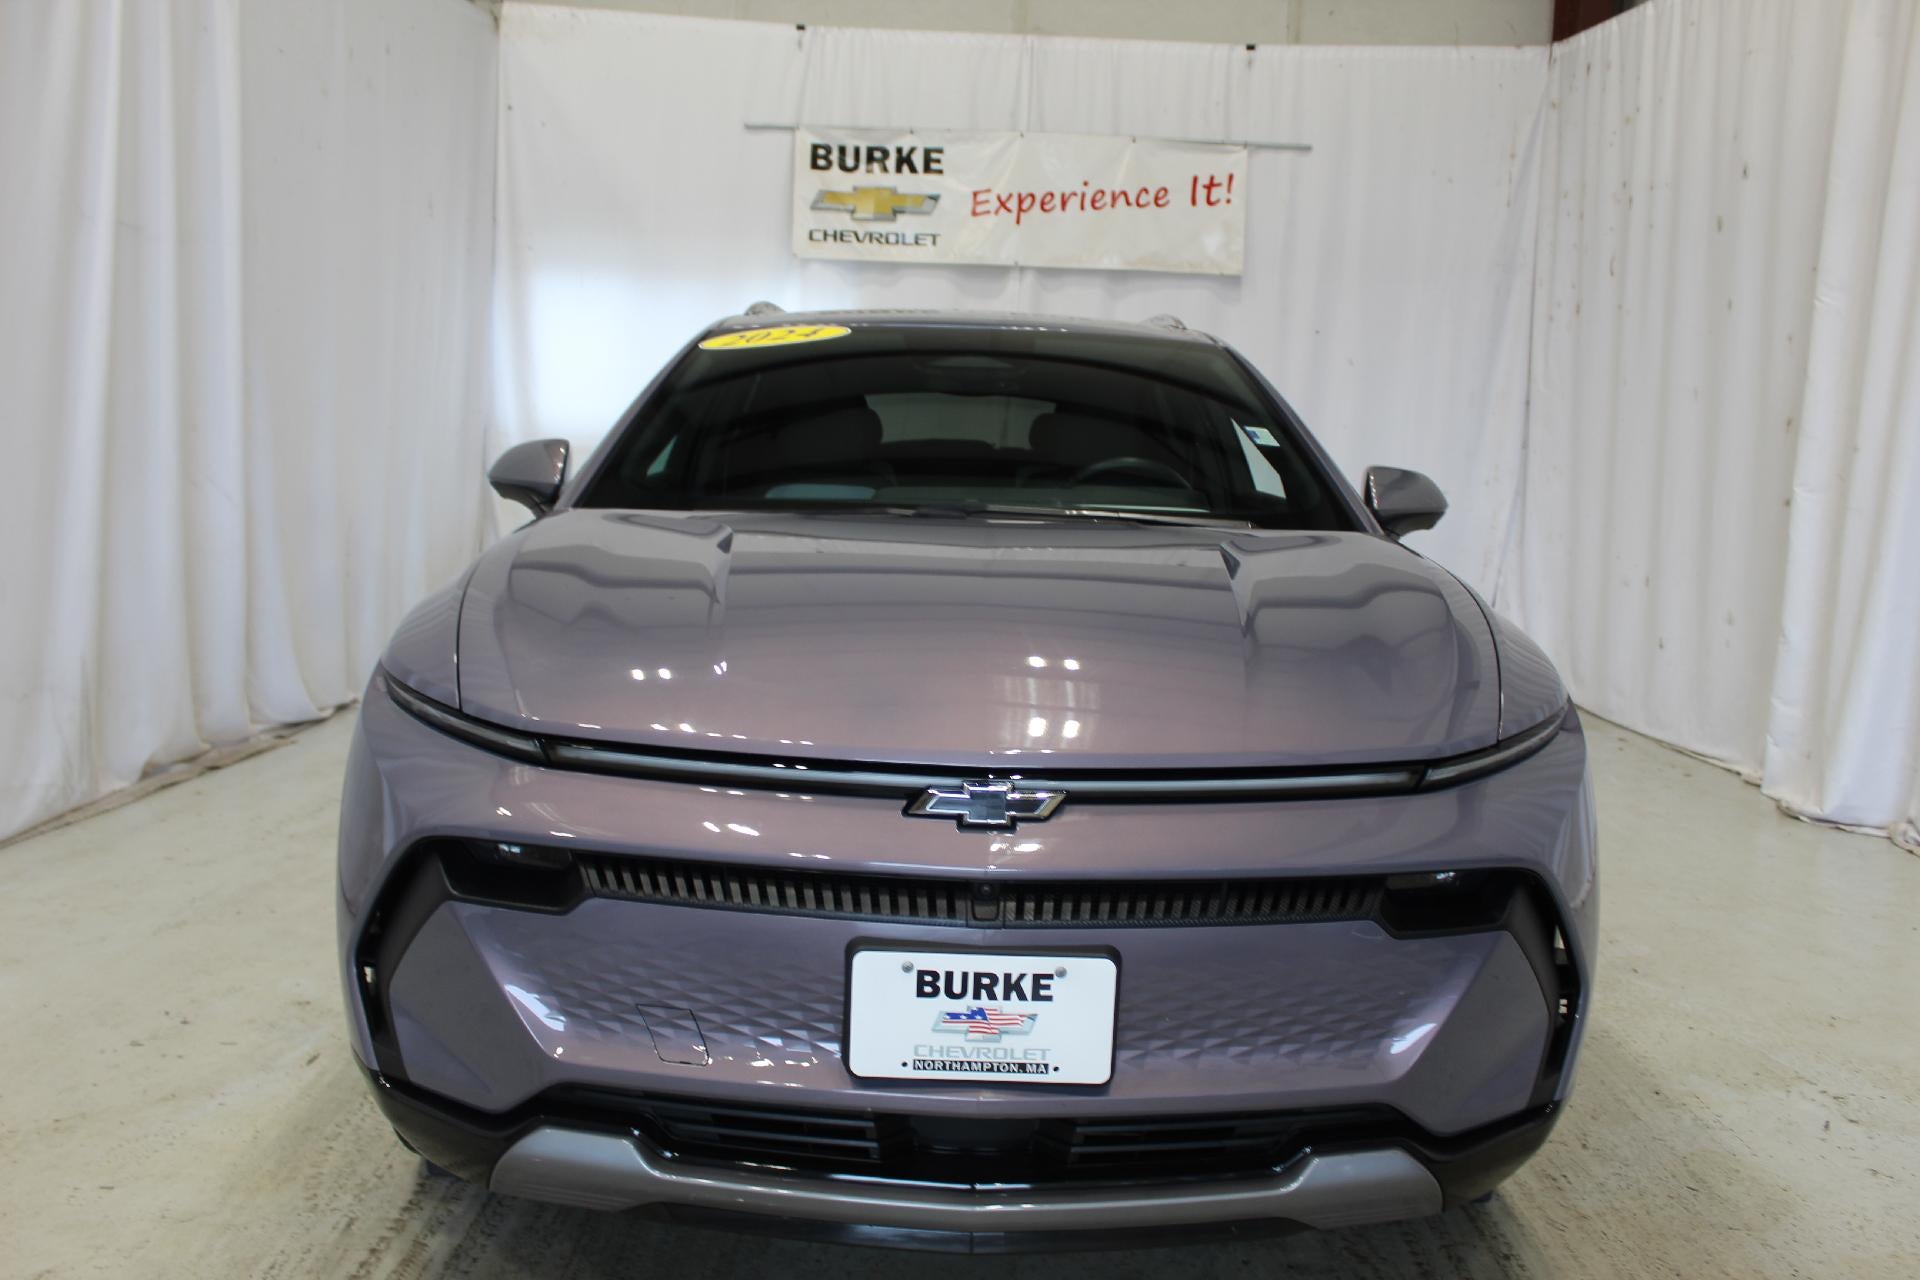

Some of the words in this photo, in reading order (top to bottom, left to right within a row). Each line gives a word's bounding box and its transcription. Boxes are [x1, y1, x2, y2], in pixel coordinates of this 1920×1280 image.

[810, 143, 944, 175] BURKE
[970, 181, 1170, 225] Experience
[1190, 174, 1235, 207] It!
[809, 229, 941, 246] CHEVROLET
[721, 326, 824, 346] 2024
[916, 969, 1054, 1001] BURKE
[914, 1044, 1051, 1061] CHEVROLET
